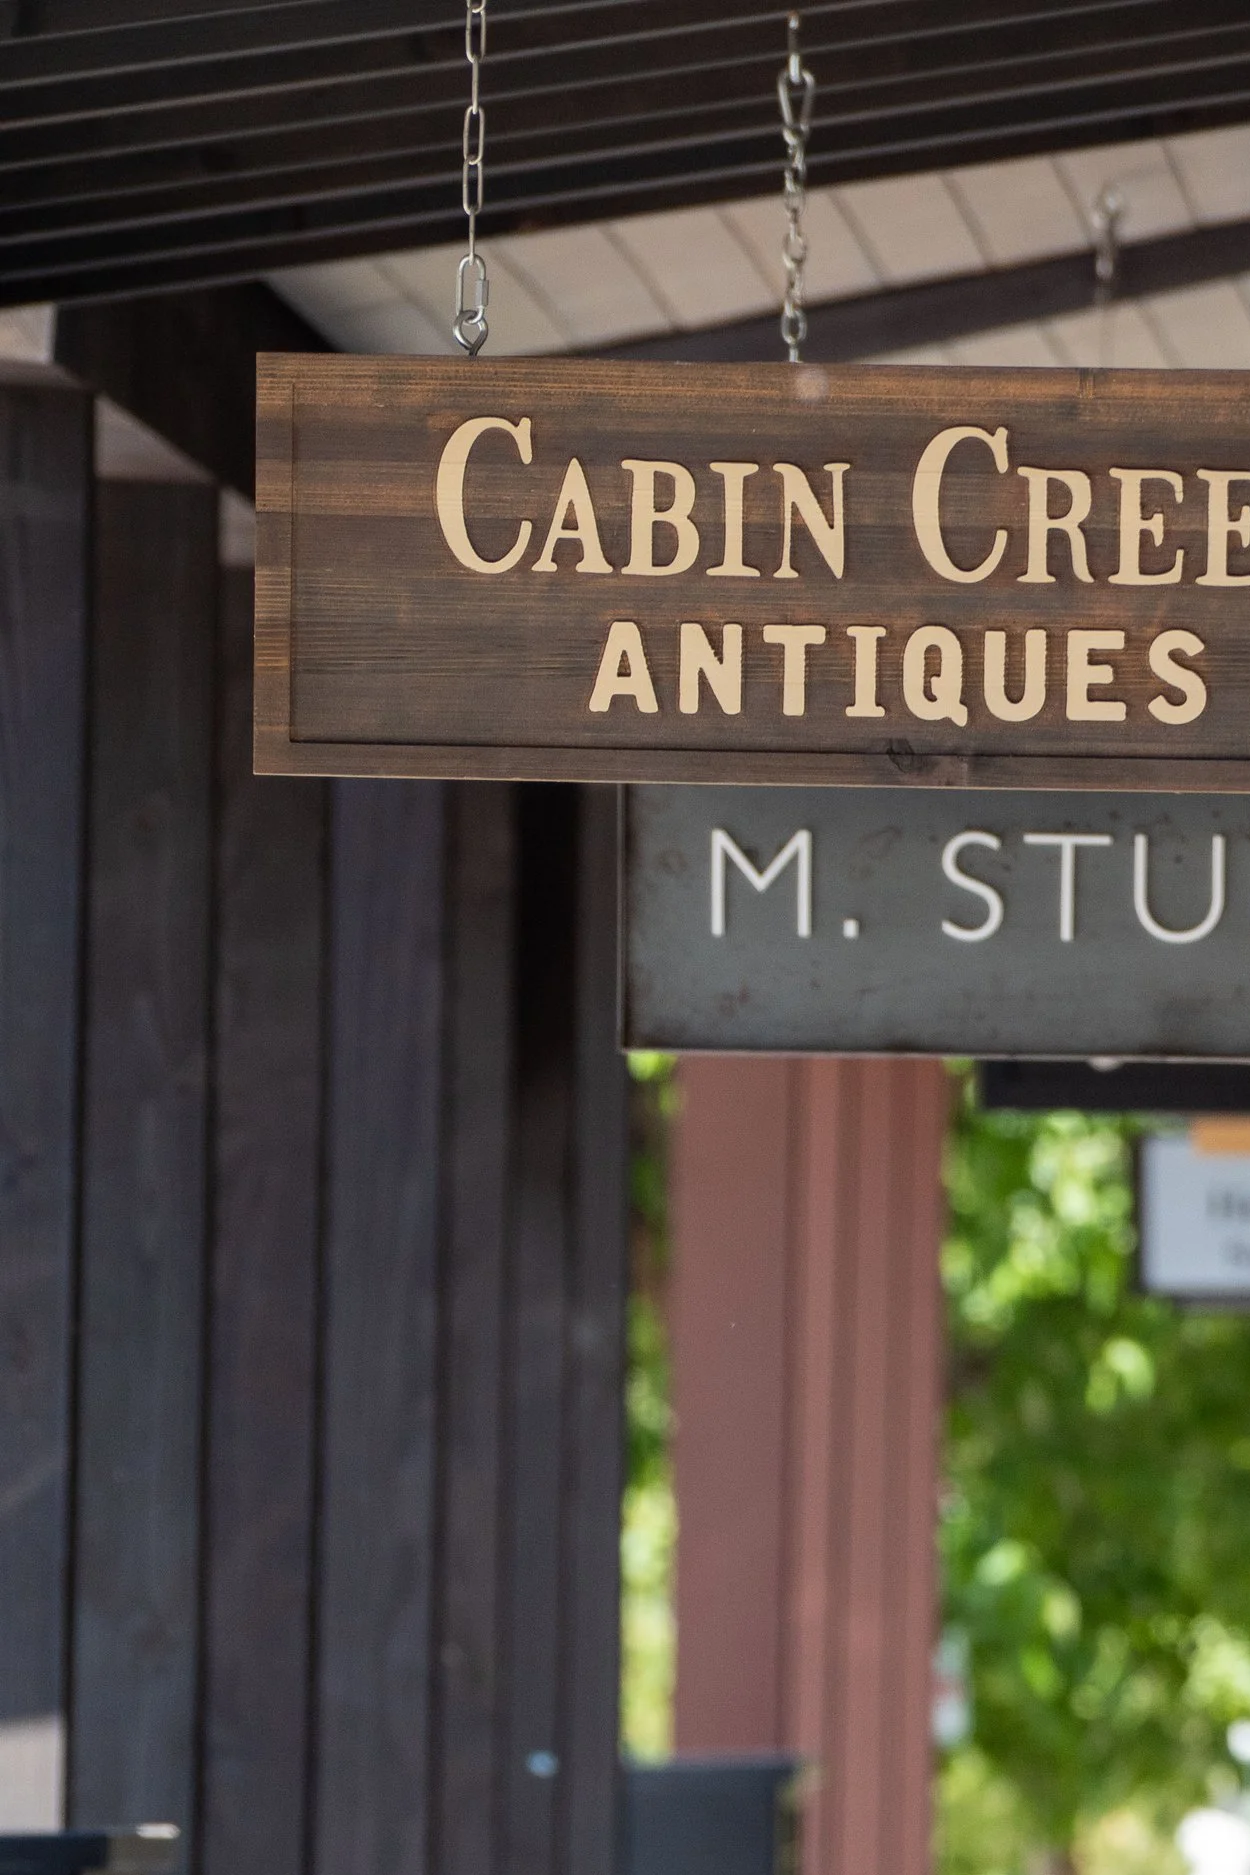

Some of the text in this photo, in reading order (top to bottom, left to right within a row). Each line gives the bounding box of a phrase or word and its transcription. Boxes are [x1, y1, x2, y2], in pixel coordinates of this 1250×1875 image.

[435, 416, 852, 580] CABIN
[588, 620, 1208, 728] ANTIQUES
[710, 828, 860, 940] M.
